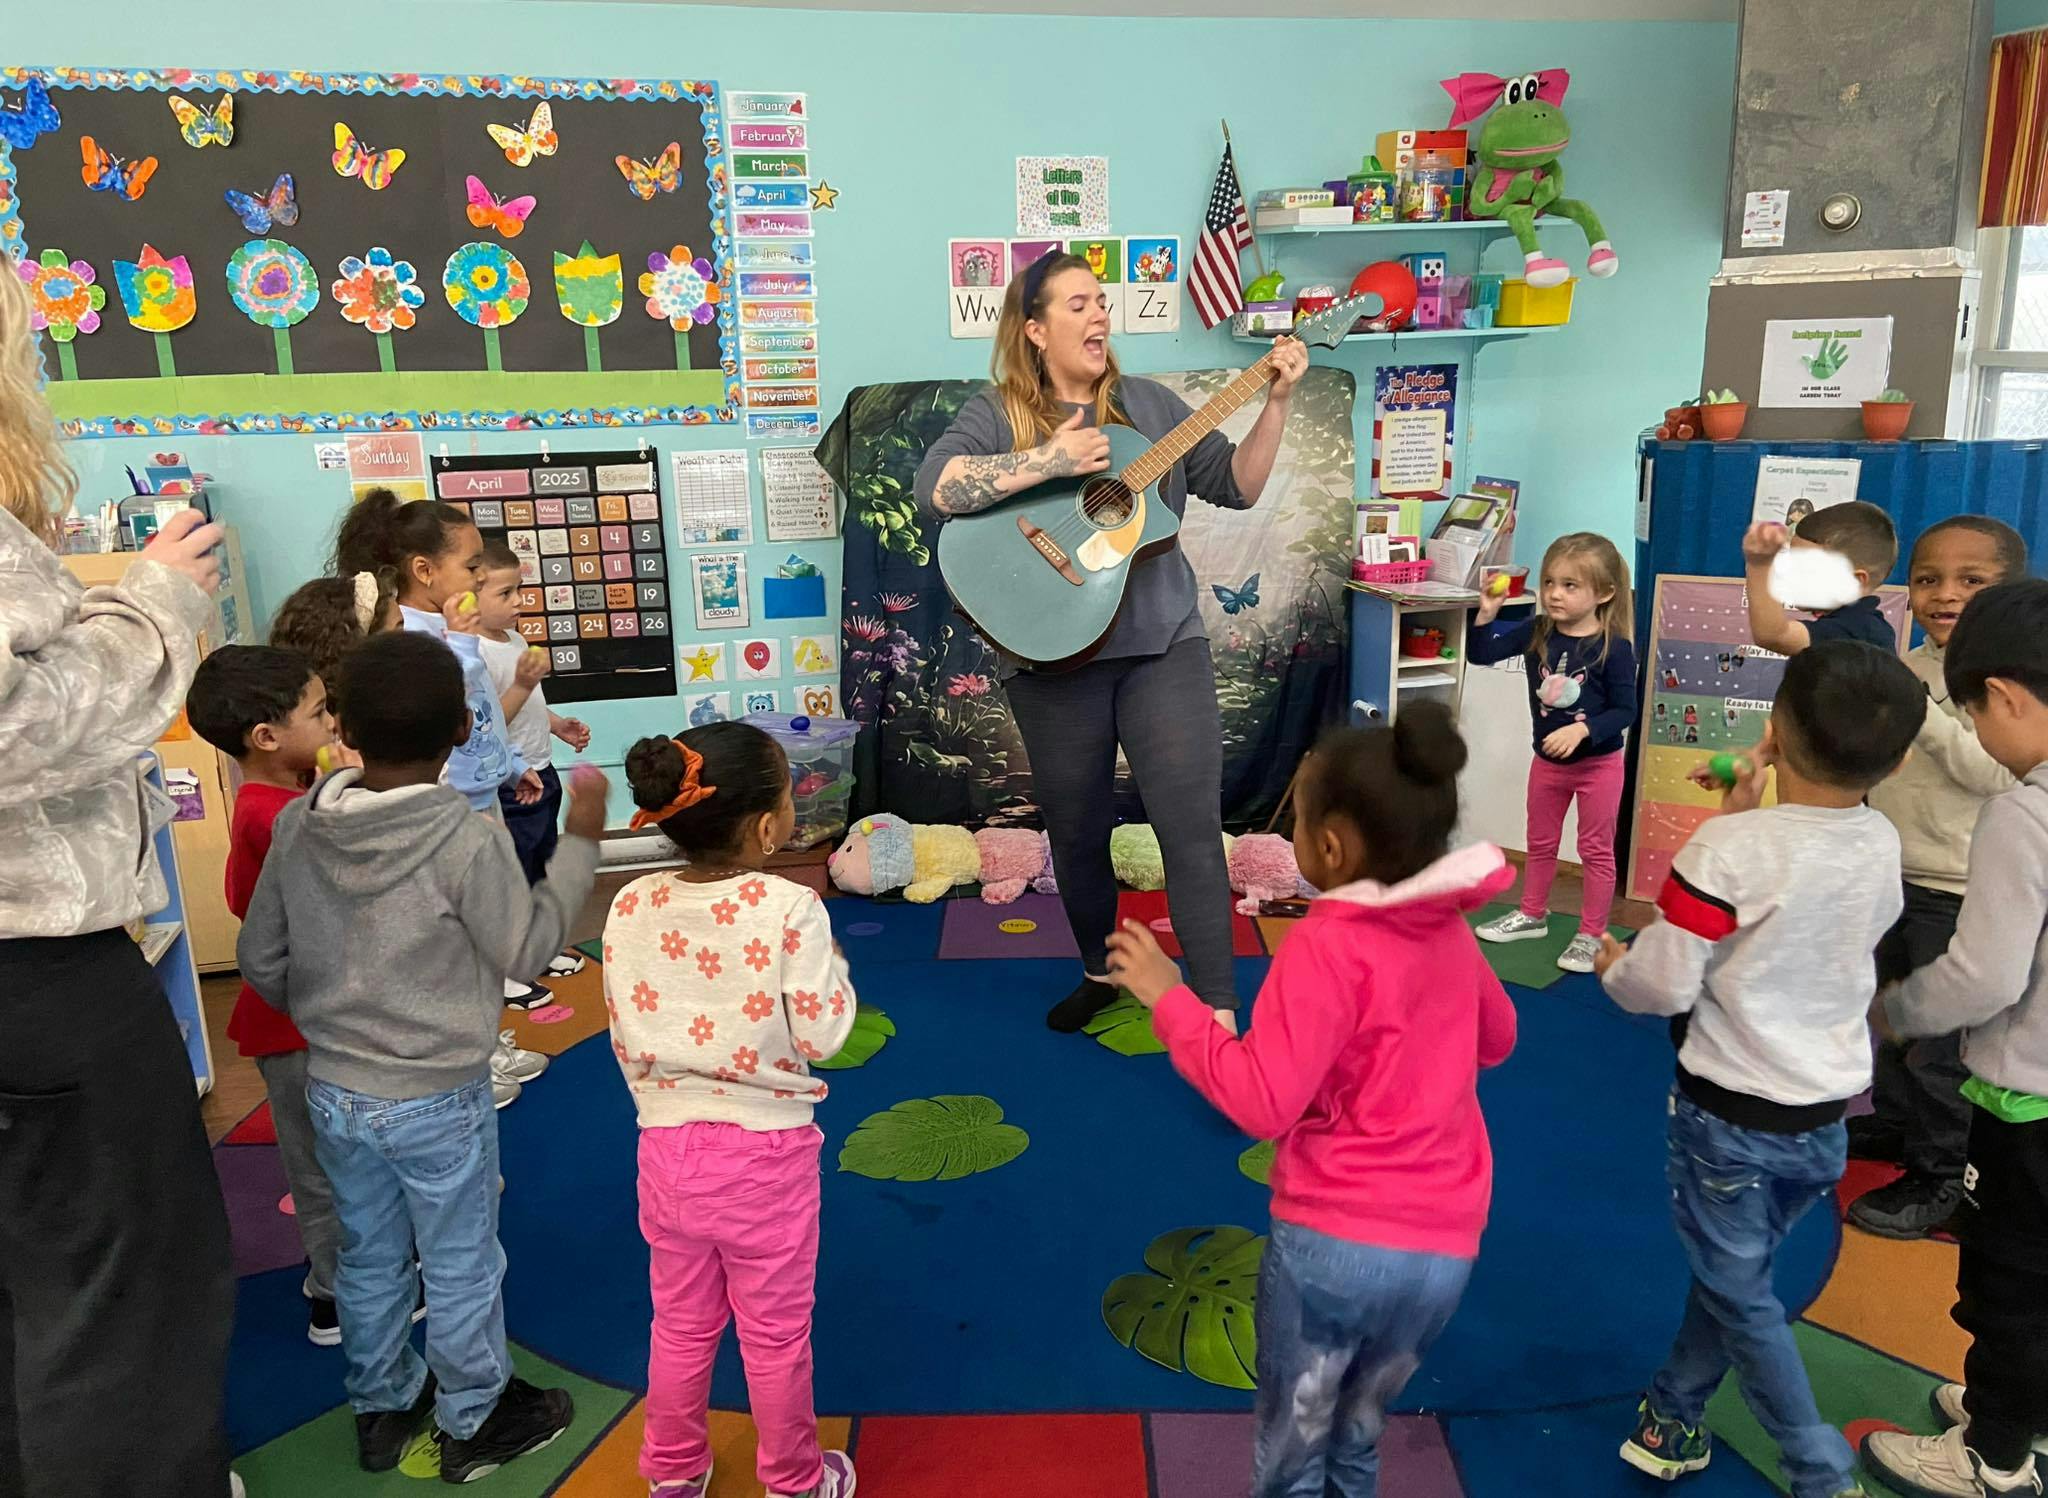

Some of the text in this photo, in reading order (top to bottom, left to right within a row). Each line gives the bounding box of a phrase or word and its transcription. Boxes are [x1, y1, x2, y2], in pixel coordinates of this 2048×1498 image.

[742, 100, 792, 115] January
[740, 129, 796, 145] February
[751, 160, 788, 171] March
[1043, 168, 1082, 184] Letters
[757, 189, 786, 202] April
[760, 219, 785, 233] May
[761, 248, 790, 260] June
[763, 280, 788, 293] July
[1137, 290, 1168, 318] Zz
[758, 308, 798, 322] August
[750, 336, 810, 348] September
[758, 363, 803, 374] October
[1405, 371, 1445, 389] Pledge
[754, 391, 811, 401] November
[1391, 388, 1451, 406] Allegiance
[756, 418, 810, 429] December
[360, 441, 410, 472] Sunday
[466, 476, 503, 493] April
[540, 473, 580, 487] 2025
[579, 534, 589, 546] 3
[609, 532, 620, 544] 4
[641, 530, 651, 542] 5
[552, 563, 562, 575] 9
[580, 562, 594, 574] 10
[613, 560, 621, 572] 11
[642, 559, 656, 571] 12
[522, 593, 536, 606] 15
[643, 588, 657, 601] 19
[708, 608, 736, 617] cloudy
[522, 623, 543, 635] 22
[552, 621, 572, 634] 23
[583, 619, 603, 632] 24
[614, 618, 634, 630] 25
[645, 617, 665, 630] 26
[556, 651, 577, 664] 30
[1726, 699, 1752, 709] Ready
